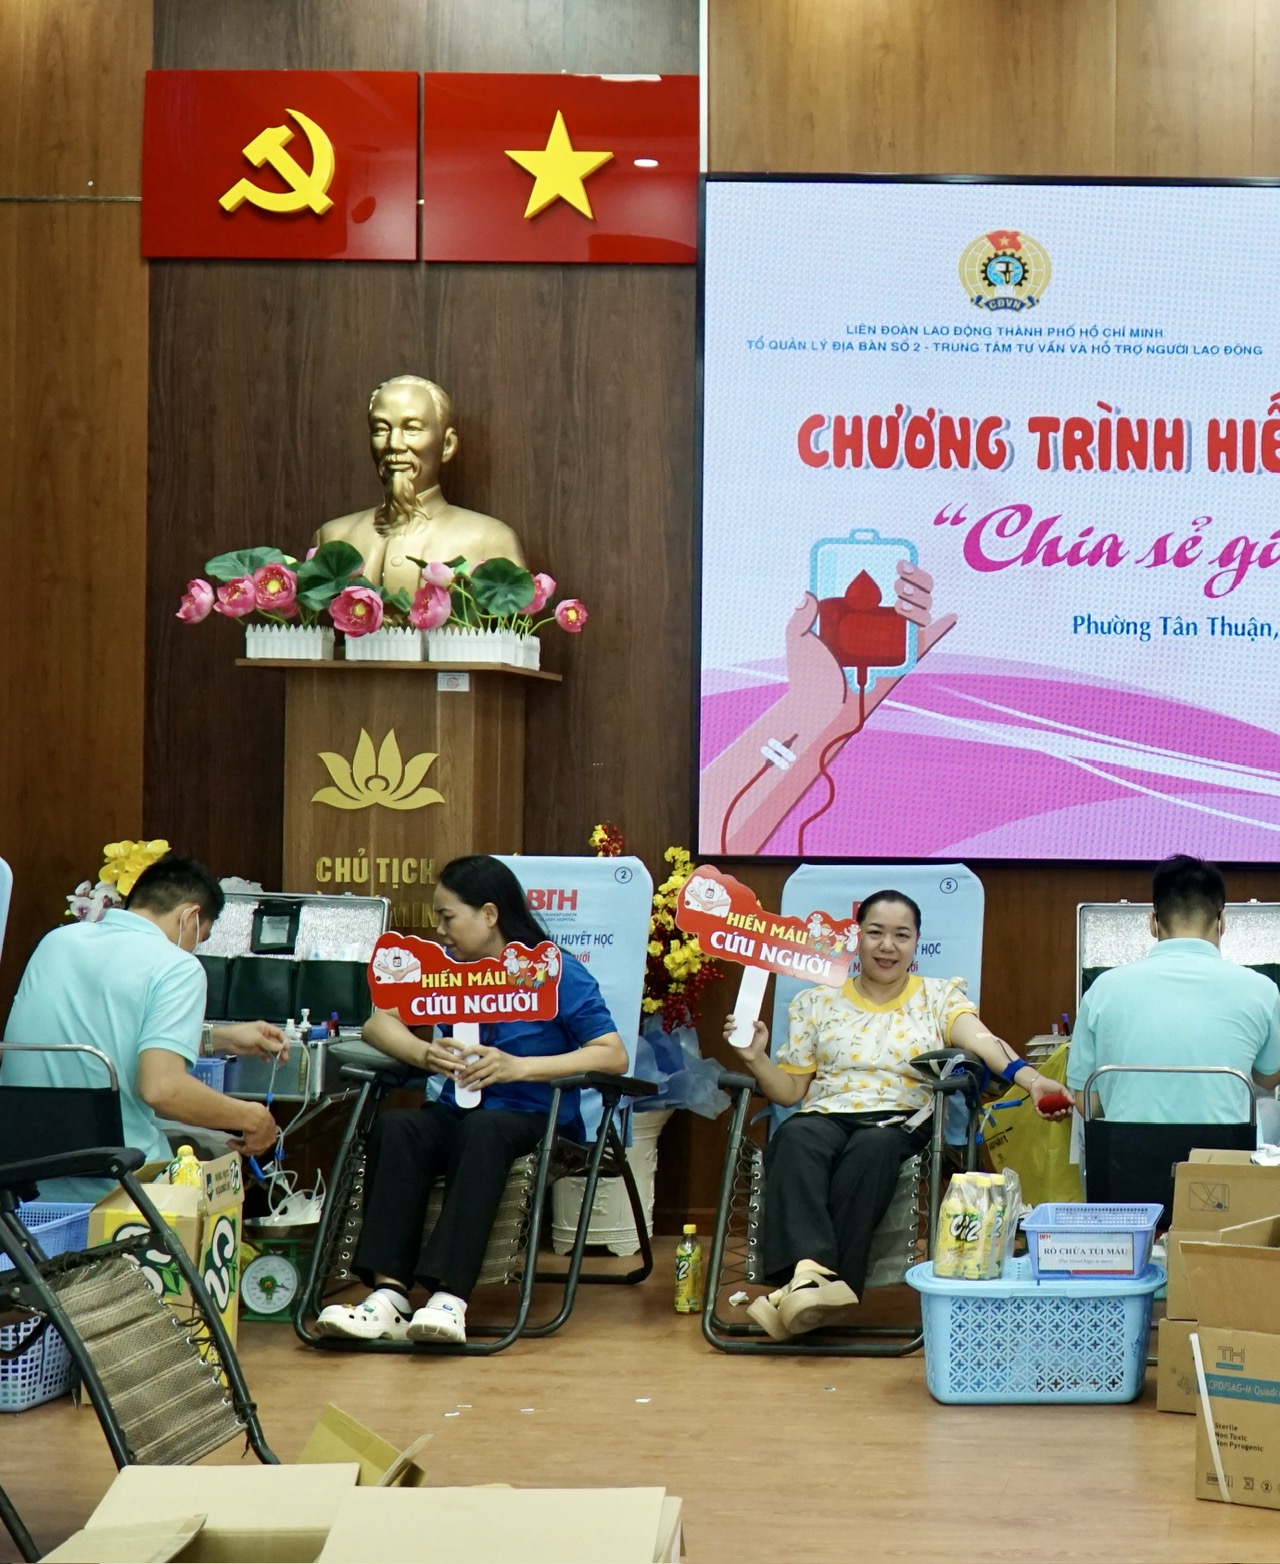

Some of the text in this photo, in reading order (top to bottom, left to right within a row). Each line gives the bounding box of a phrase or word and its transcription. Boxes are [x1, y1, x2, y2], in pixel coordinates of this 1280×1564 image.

[846, 323, 1164, 338] LIÊN ĐOÀN LAO ĐỘNG THÀNH PHỐ HỒ CHÍ MINH
[746, 335, 765, 350] TỔ
[768, 338, 806, 351] QUẢN
[811, 338, 828, 350] LÝ
[831, 340, 855, 353] ĐỊA
[858, 339, 887, 351] BÀN
[890, 338, 910, 351] SỐ
[912, 342, 921, 351] 2
[933, 341, 979, 353] TRUNG
[984, 340, 1012, 353] TÂM
[1016, 343, 1036, 353] TƯ
[1038, 340, 1065, 354] VẤN
[1070, 340, 1088, 354] VÀ
[1091, 339, 1111, 354] HỖ
[1115, 344, 1143, 356] TRỢ
[1146, 342, 1189, 355] NGƯỜI
[1193, 345, 1220, 355] LAO
[1224, 343, 1263, 356] ĐỘNG
[798, 403, 1012, 471] CHƯƠNG
[1027, 400, 1190, 473] TRÌNH
[1138, 513, 1213, 570] sẻ
[1072, 613, 1152, 642] Phường
[1158, 615, 1199, 636] Tân
[1206, 615, 1279, 642] Thuận,
[315, 847, 437, 889] CHỦ TỊCH
[620, 870, 627, 879] 2
[945, 881, 953, 890] 5
[526, 889, 578, 911] BTH
[725, 912, 809, 945] HIẾN MÁU
[560, 930, 592, 945] HUYẾT
[593, 933, 614, 949] HỌC
[921, 942, 942, 958] HỌC
[709, 930, 833, 978] CỨU NGƯỜI
[421, 968, 507, 989] HIẾN MÁU
[410, 989, 539, 1016] CỨU NGƯỜI
[1059, 1246, 1086, 1255] CHỨA
[1088, 1246, 1104, 1255] TÚI
[1106, 1246, 1128, 1255] MÁU
[1214, 1422, 1239, 1432] Sterile
[1229, 1432, 1248, 1442] Toxic
[1229, 1441, 1264, 1452] Pyrogenic
